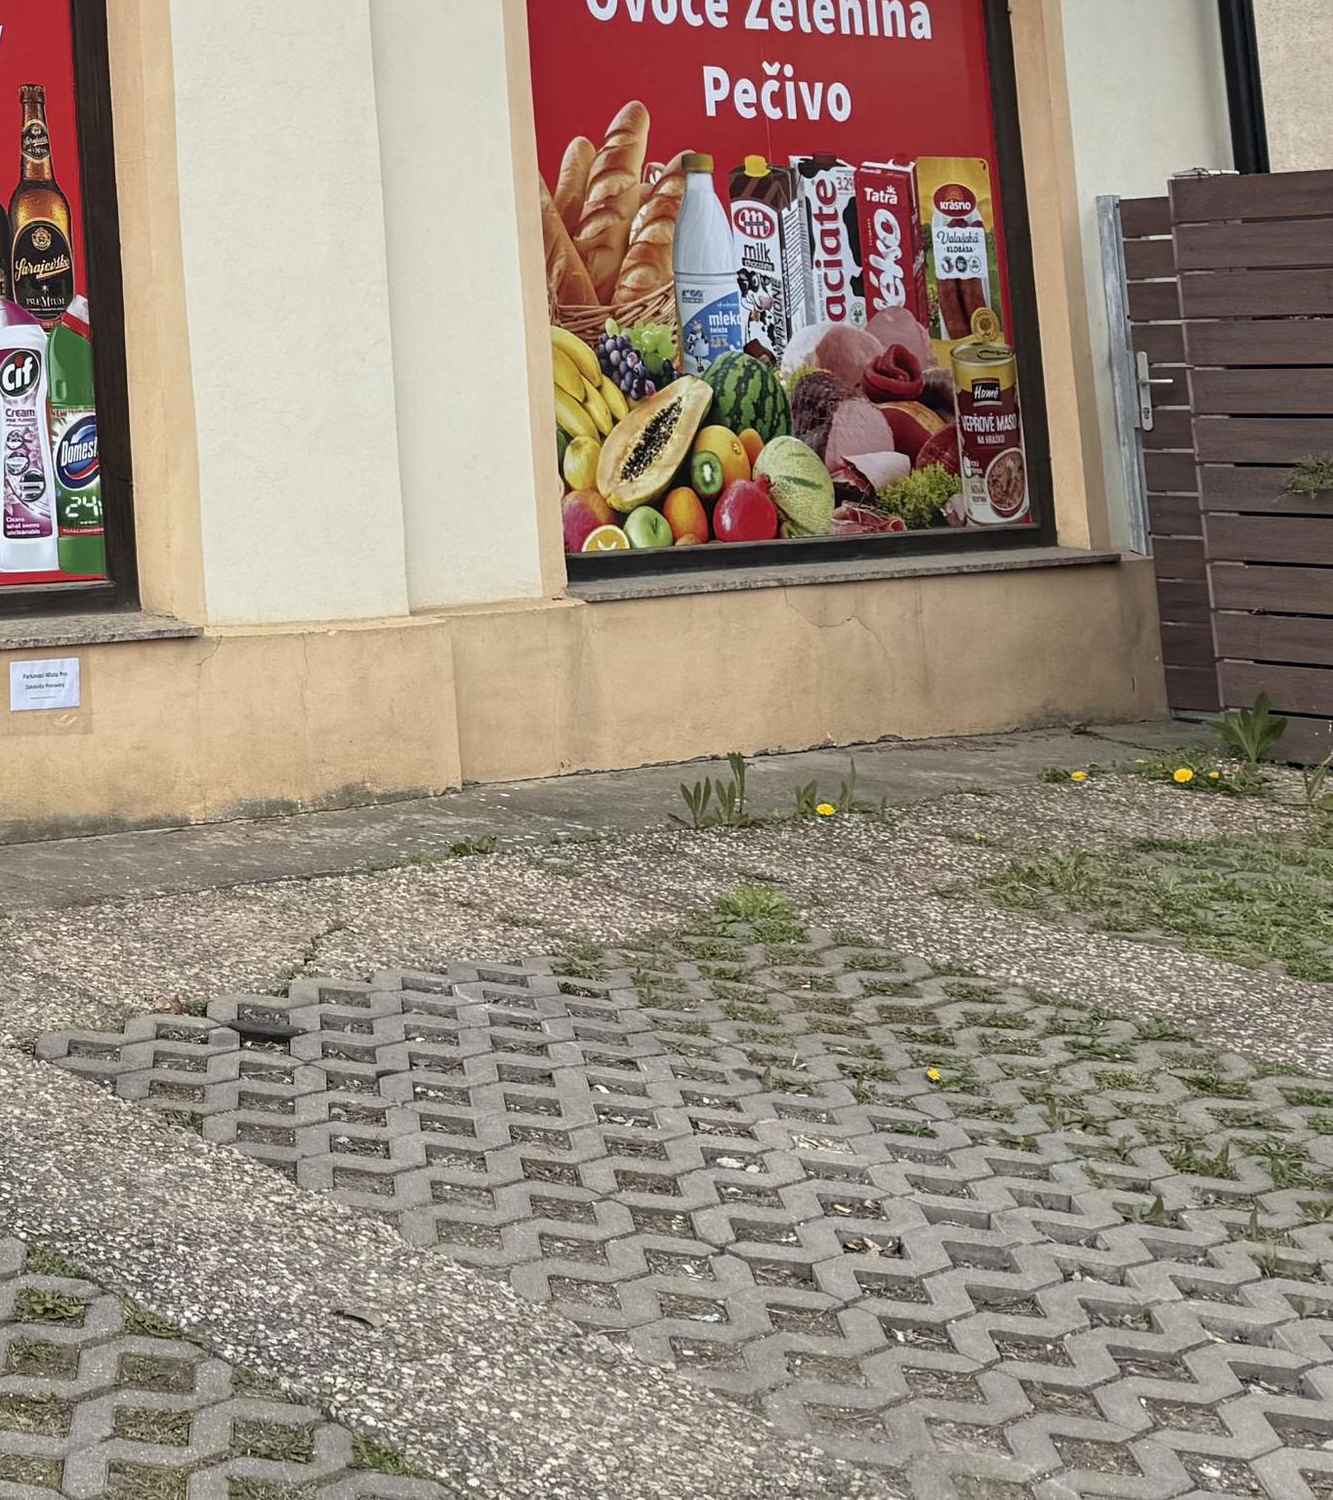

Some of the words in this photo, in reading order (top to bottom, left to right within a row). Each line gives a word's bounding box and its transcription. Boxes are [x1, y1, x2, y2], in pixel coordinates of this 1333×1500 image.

[702, 60, 853, 122] Pečivo
[864, 187, 898, 205] Tatra
[744, 242, 771, 262] milk
[813, 178, 847, 322] aciate
[869, 208, 906, 311] éko
[2, 356, 33, 391] Cif
[973, 384, 1000, 400] Hamé
[6, 408, 35, 417] Cream
[960, 412, 995, 433] VEPŘOVÉ
[996, 413, 1018, 432] MASO
